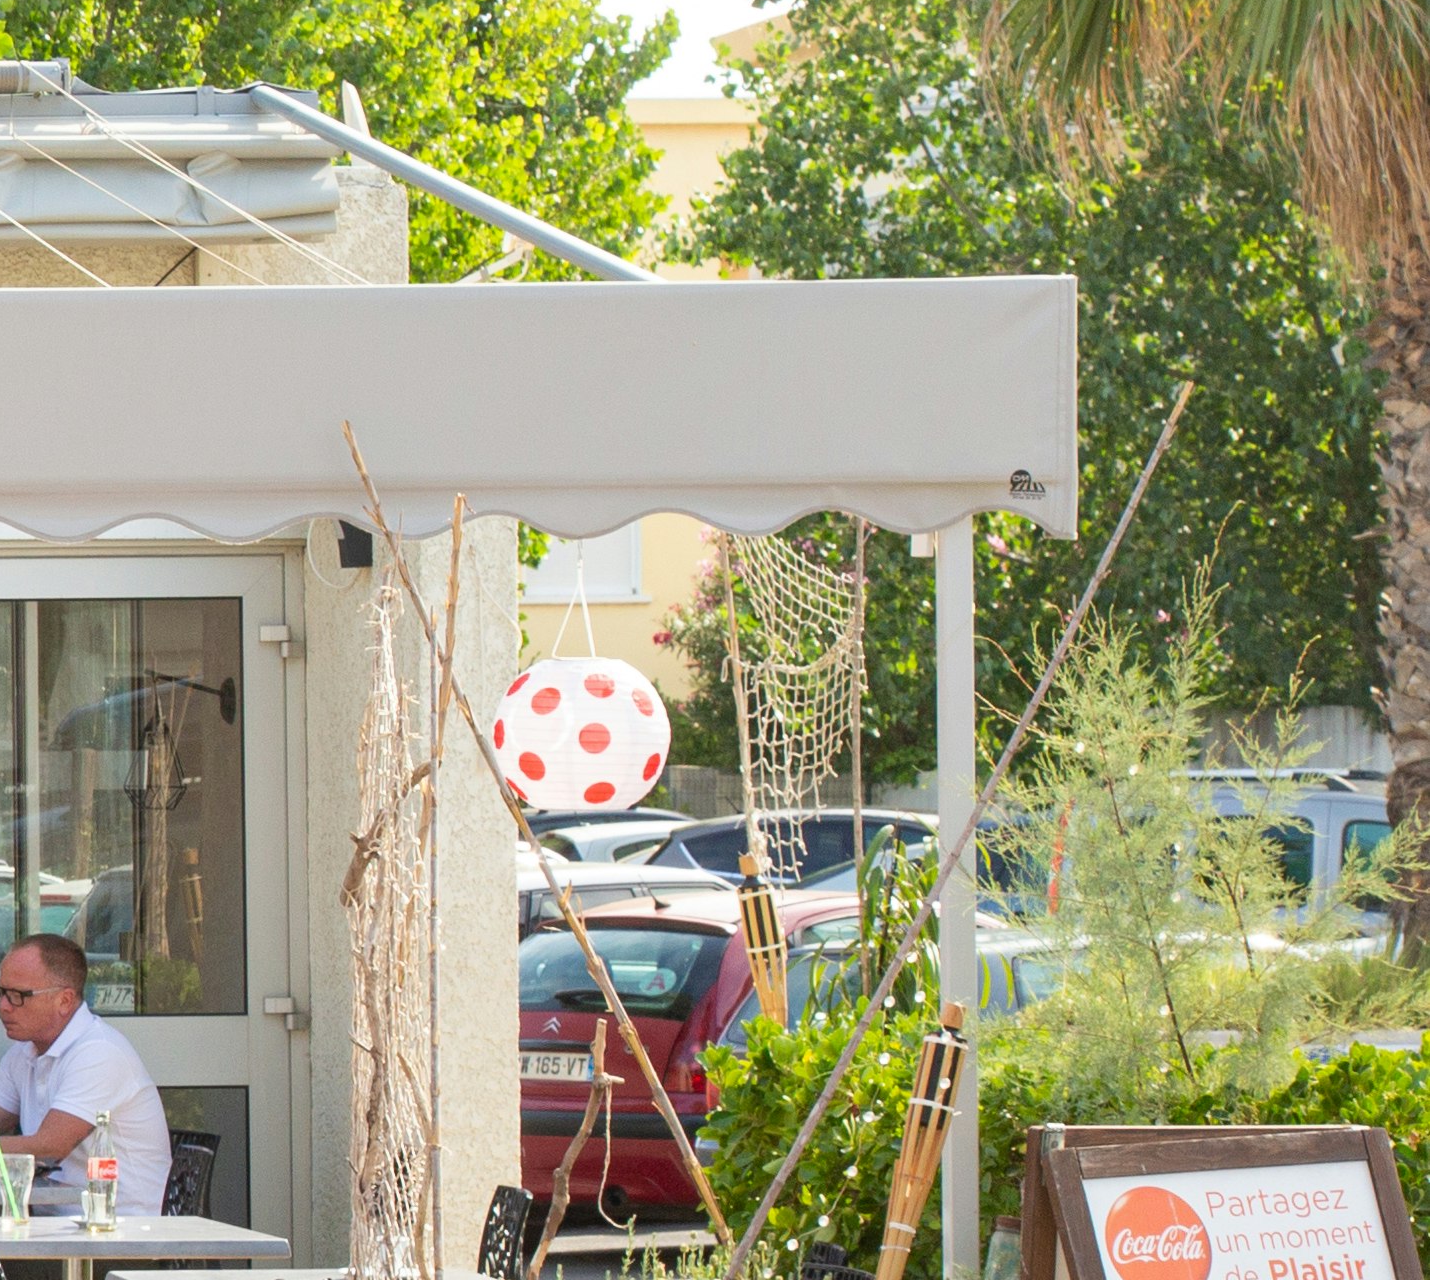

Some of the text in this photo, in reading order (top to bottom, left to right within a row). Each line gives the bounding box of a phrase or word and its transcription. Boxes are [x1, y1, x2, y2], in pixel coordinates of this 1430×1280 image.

[1112, 1188, 1349, 1265] Coca-Cola Partagez
[1216, 1220, 1376, 1254] un moment
